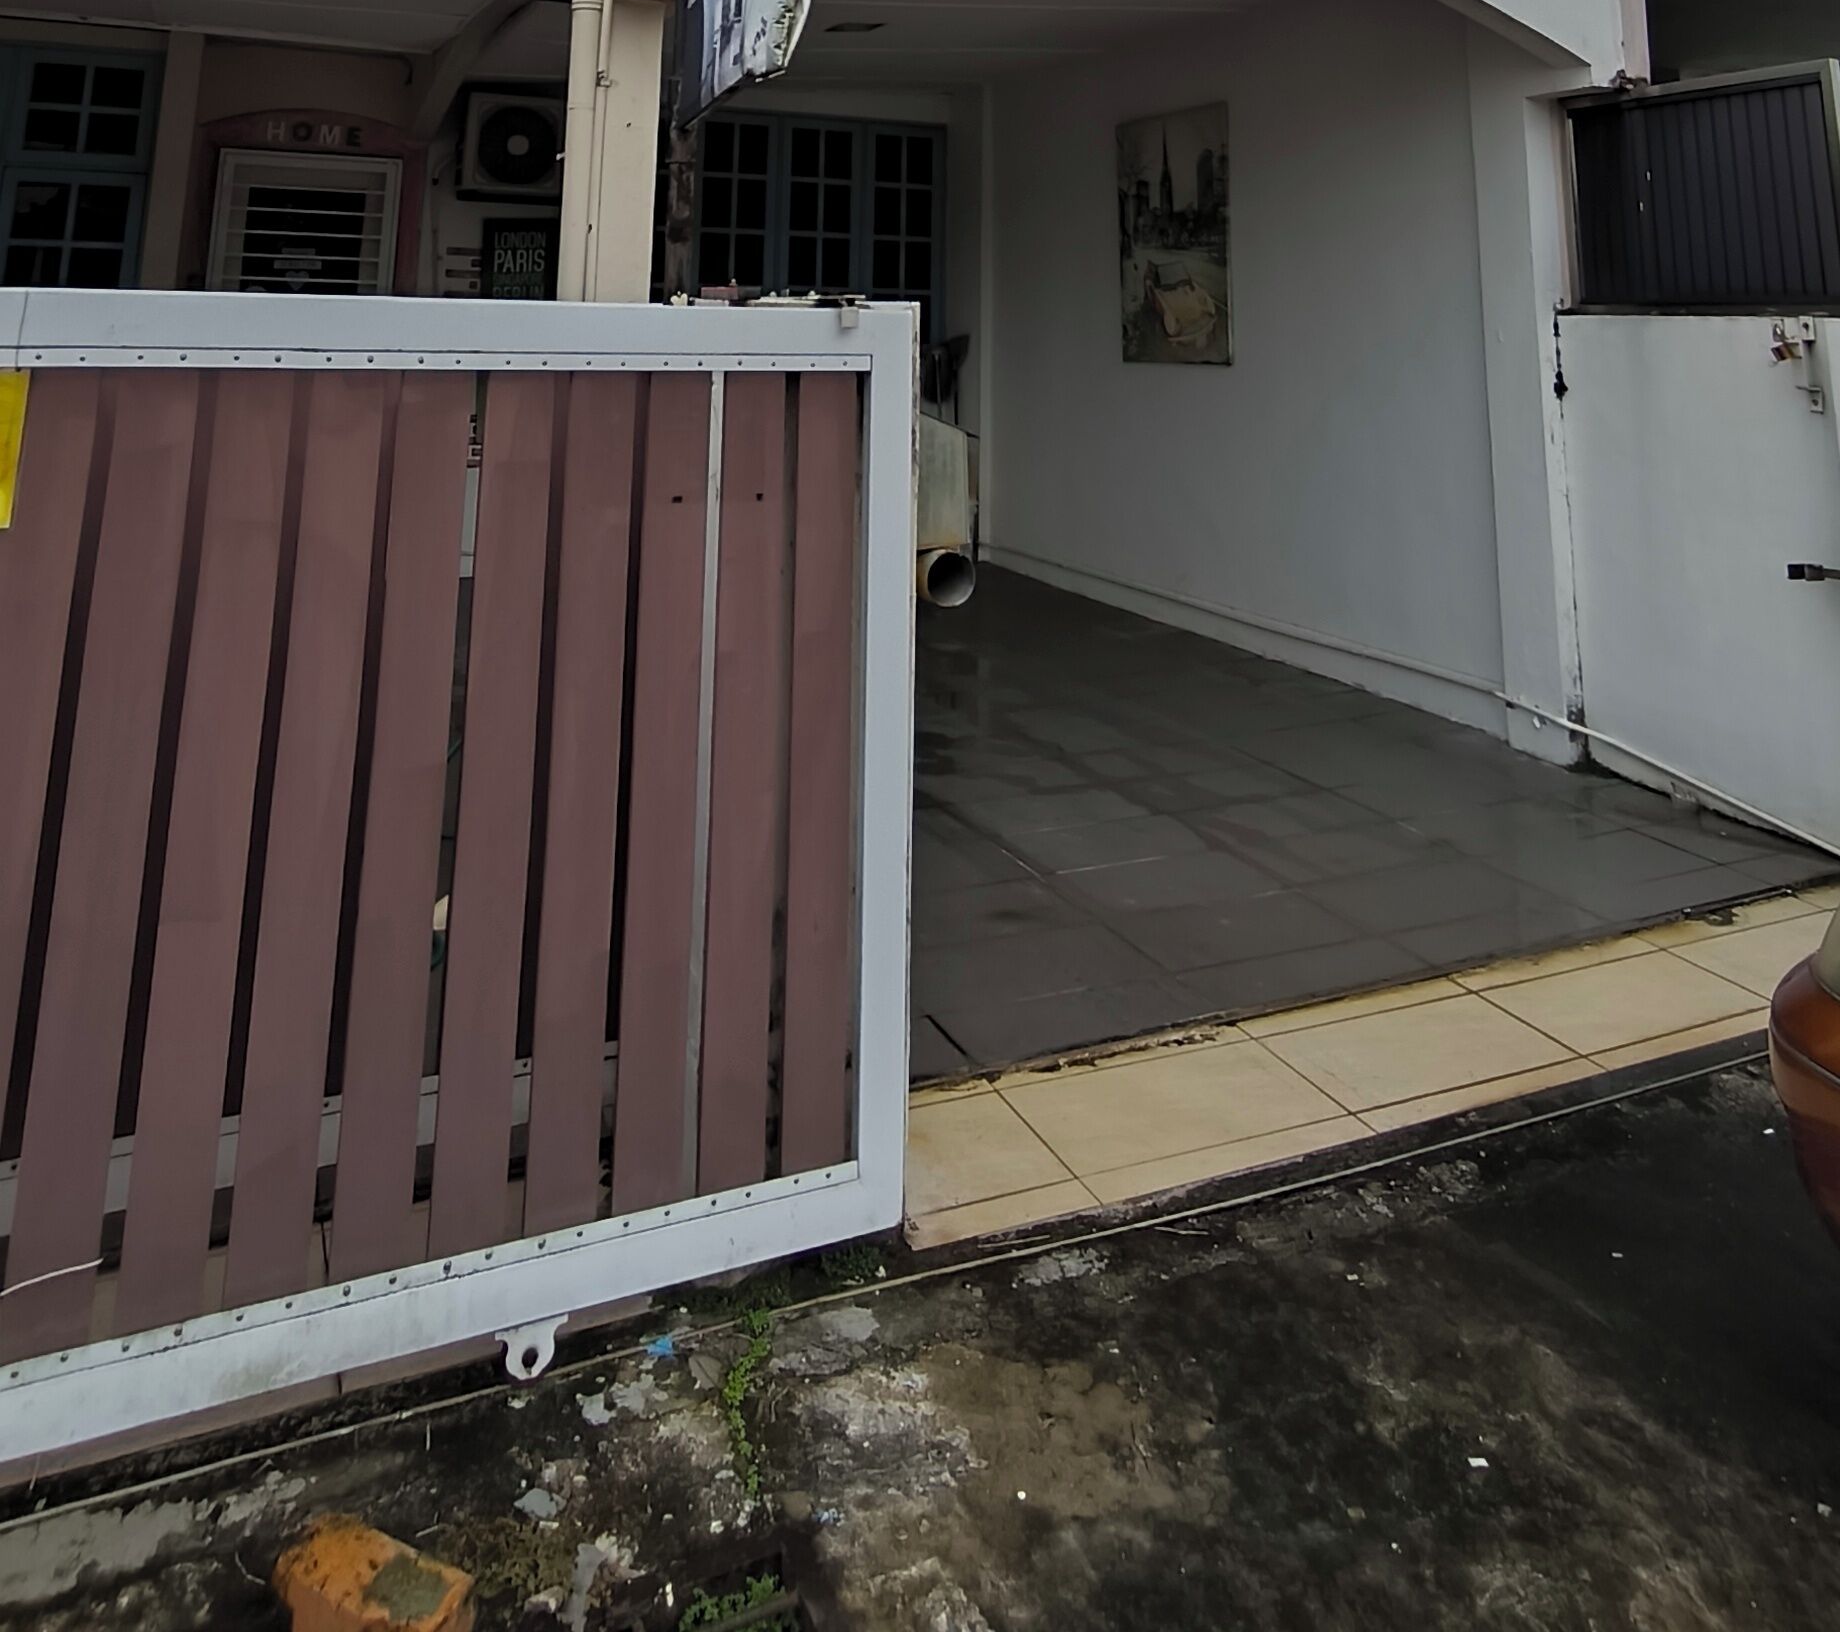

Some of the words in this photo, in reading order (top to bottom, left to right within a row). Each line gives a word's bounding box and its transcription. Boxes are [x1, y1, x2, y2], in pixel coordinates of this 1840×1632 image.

[266, 120, 362, 147] HOME
[494, 231, 546, 249] LONDON
[493, 248, 546, 273] PARIS
